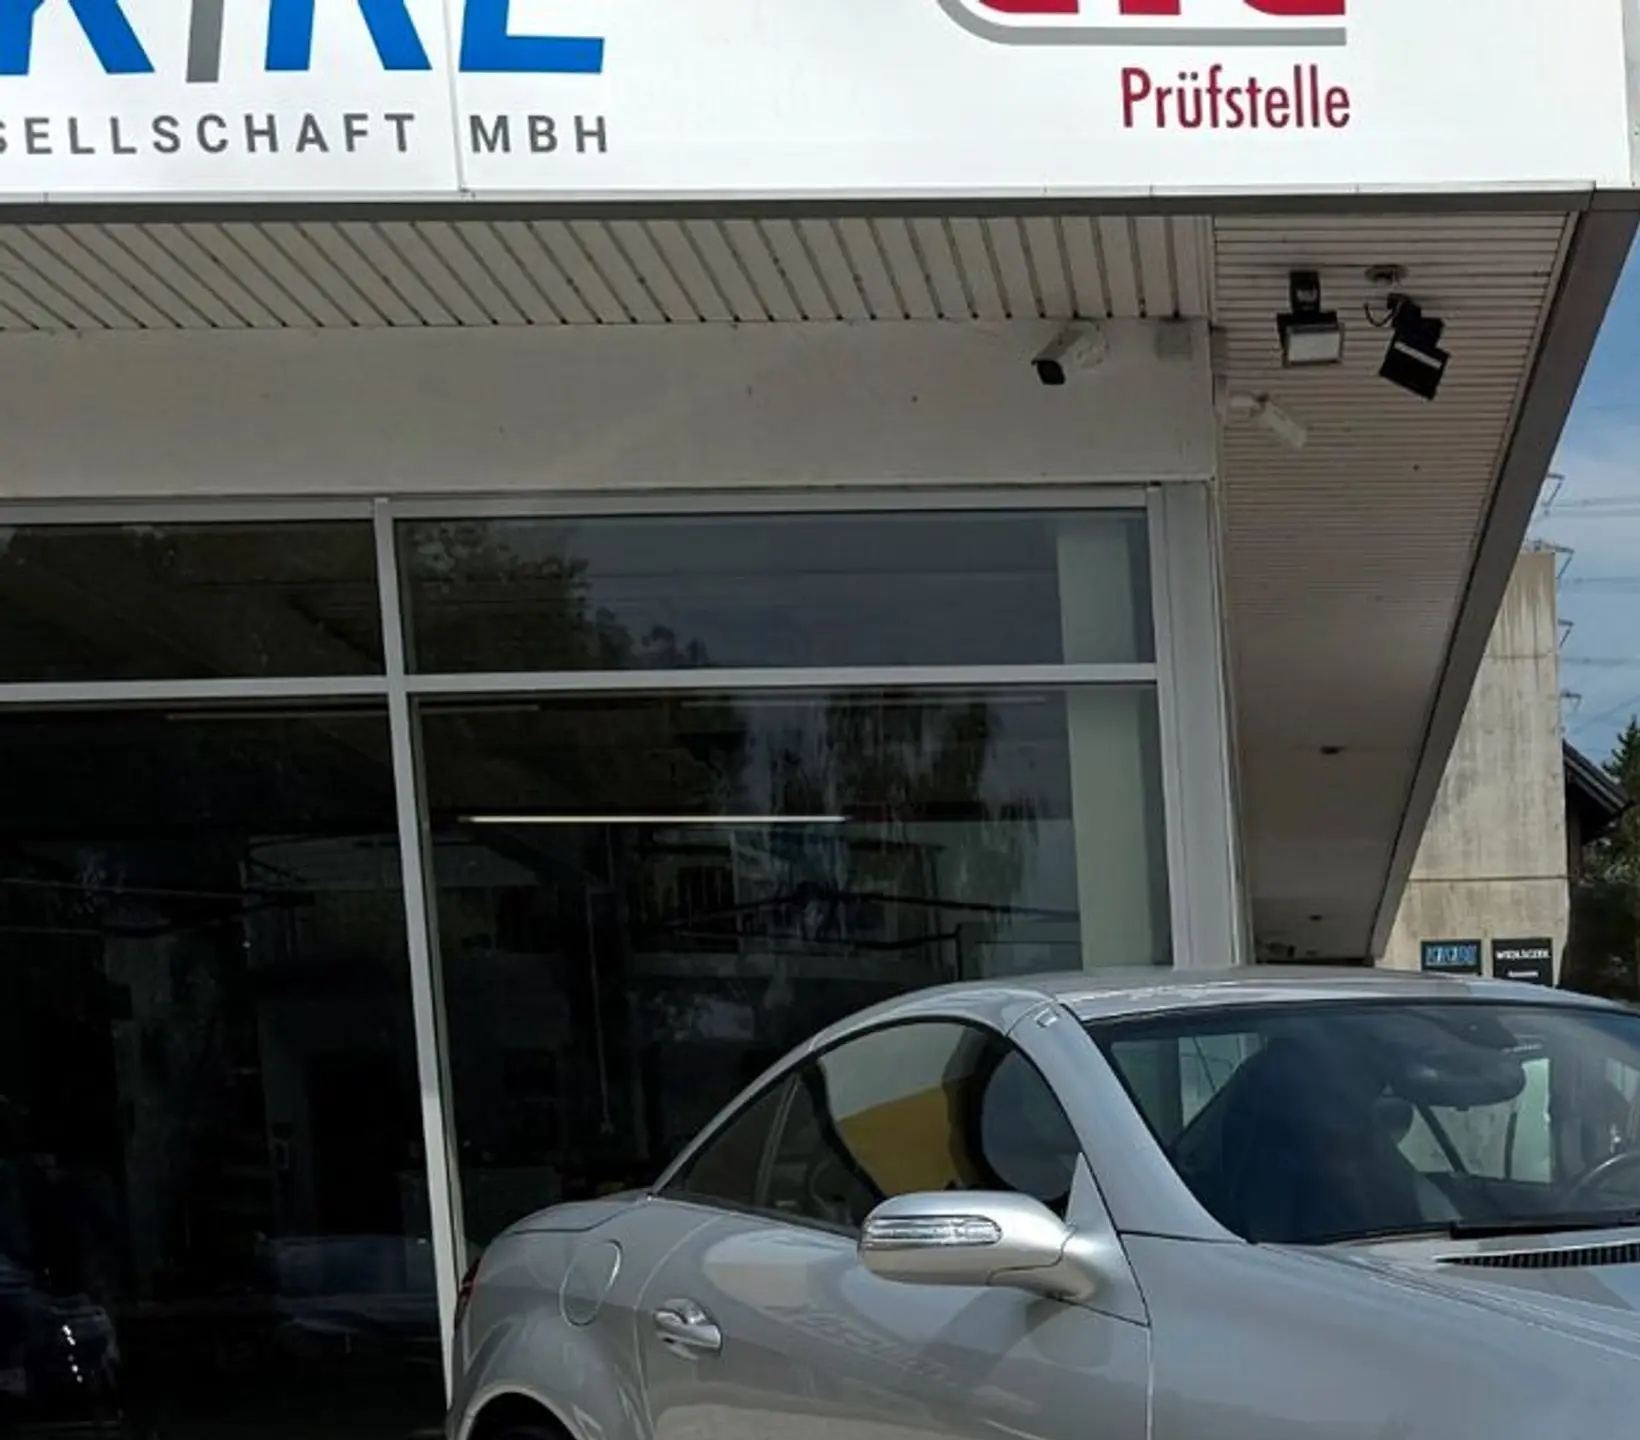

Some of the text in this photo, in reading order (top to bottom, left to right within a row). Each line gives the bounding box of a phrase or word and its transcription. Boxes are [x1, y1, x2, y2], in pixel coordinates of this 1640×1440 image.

[1121, 63, 1350, 128] Prüfstelle
[0, 113, 608, 155] ELLSCHAFT MBH
